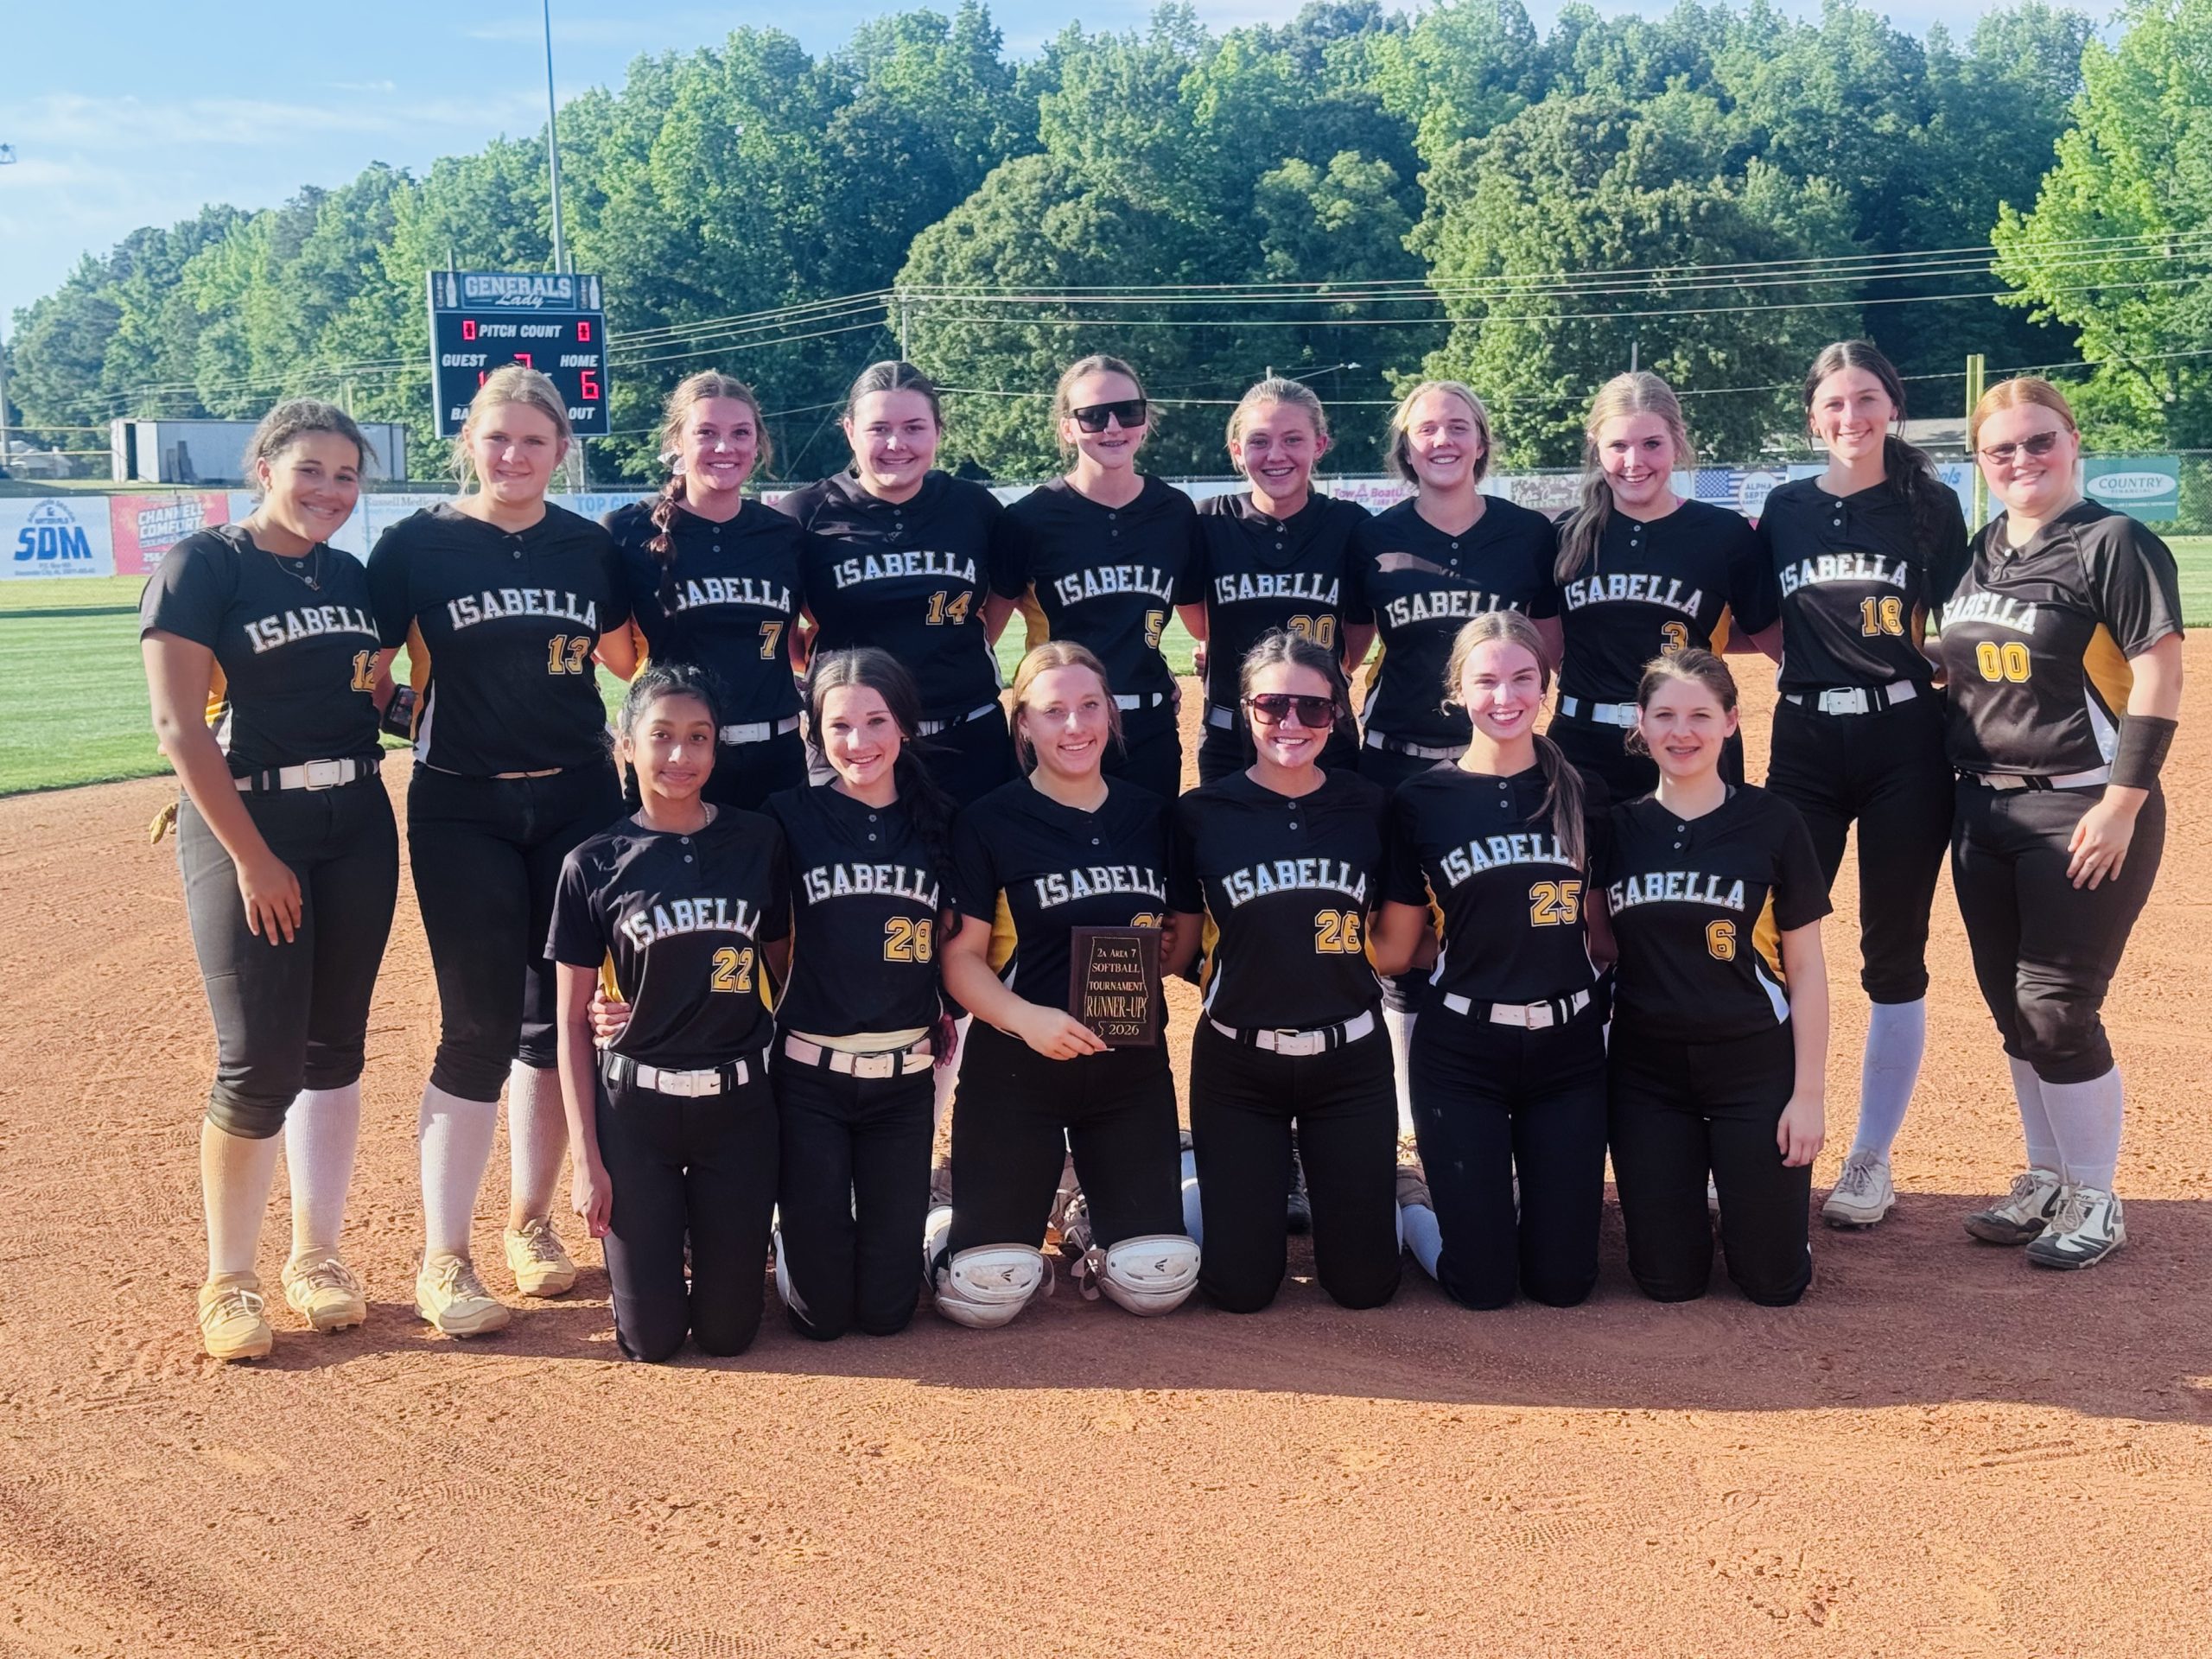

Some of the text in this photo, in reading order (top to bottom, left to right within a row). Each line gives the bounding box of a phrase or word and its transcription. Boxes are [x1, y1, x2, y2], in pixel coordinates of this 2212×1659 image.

[465, 276, 572, 299] GENERALS
[495, 292, 544, 308] Lady
[480, 325, 563, 338] PITCH COUNT
[442, 354, 487, 367] GUEST
[560, 355, 599, 367] HOME
[581, 371, 599, 399] 6
[569, 407, 595, 420] OUT
[1334, 488, 1355, 498] Tow
[1745, 483, 1772, 494] ALPHA
[2098, 477, 2163, 489] COUNTRY
[575, 497, 606, 512] TOP
[14, 526, 92, 561] SDM
[832, 550, 976, 590] ISABELLA
[1053, 564, 1174, 607] ISABELLA
[1778, 552, 1908, 600] ISABELLA
[1214, 572, 1339, 606] ISABELLA
[1564, 573, 1703, 620] ISABELLA
[447, 587, 597, 631] ISABELLA
[925, 590, 974, 626] 14
[1384, 590, 1519, 628] ISABELL
[759, 620, 784, 660] 7
[1144, 609, 1164, 650] 5
[1661, 620, 1689, 657] 3
[547, 634, 591, 676] 13
[1975, 641, 2032, 683] 00
[1440, 833, 1579, 888] ISABELL
[802, 862, 940, 913] ISABELLA
[1221, 857, 1366, 909] ISABELLA
[1605, 871, 1745, 918] ISABELLA
[1529, 880, 1582, 928] 25
[883, 916, 933, 964] 28
[1314, 909, 1363, 954] 26
[1706, 918, 1737, 962] 6
[710, 946, 754, 994] 22
[1091, 963, 1141, 973] SOFTBALL
[1130, 948, 1137, 958] 7
[1089, 981, 1144, 992] TOURNAMENT
[1086, 995, 1145, 1018] RUNNER-UP
[1109, 1024, 1140, 1036] 2026
